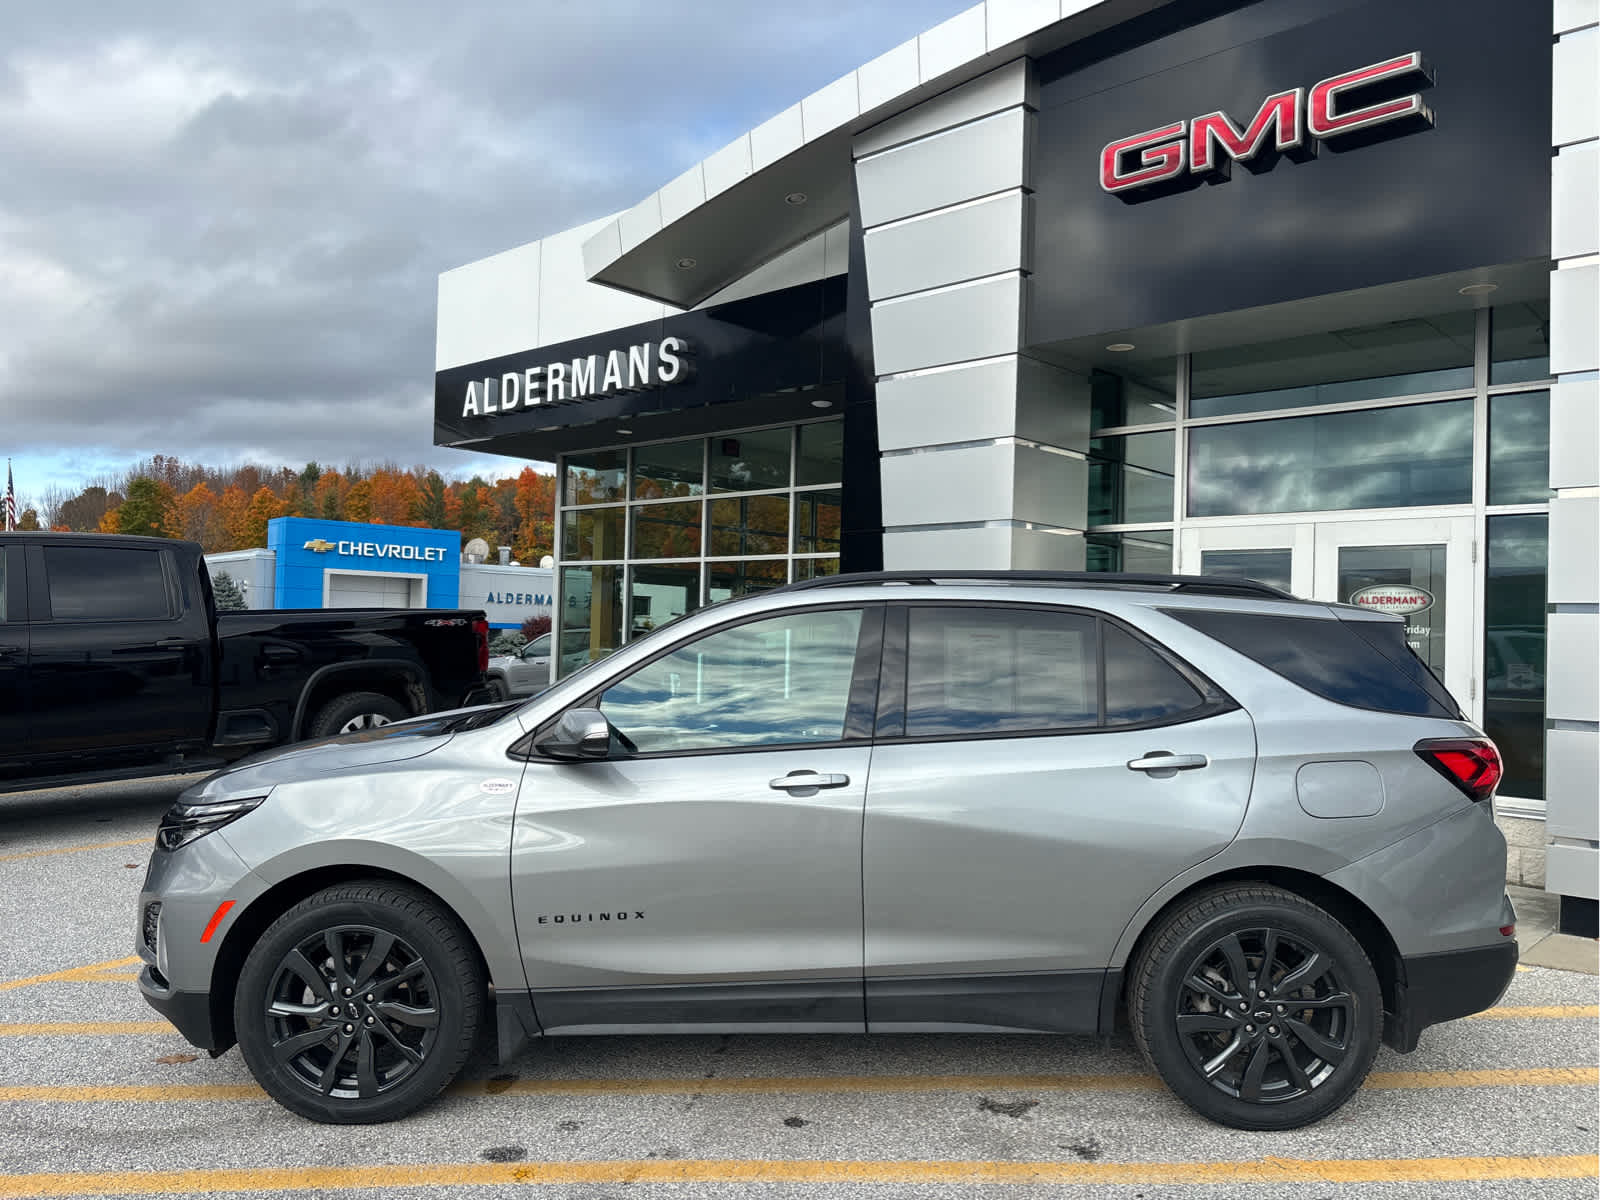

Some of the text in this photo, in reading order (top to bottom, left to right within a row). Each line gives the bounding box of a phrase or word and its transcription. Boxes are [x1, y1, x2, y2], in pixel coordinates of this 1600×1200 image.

[1099, 50, 1423, 193] GMC
[462, 336, 684, 417] ALDERMANS
[338, 540, 448, 562] CHEVROLET
[1358, 595, 1427, 605] ALDERMAN'S
[538, 911, 645, 924] EQUINOX
